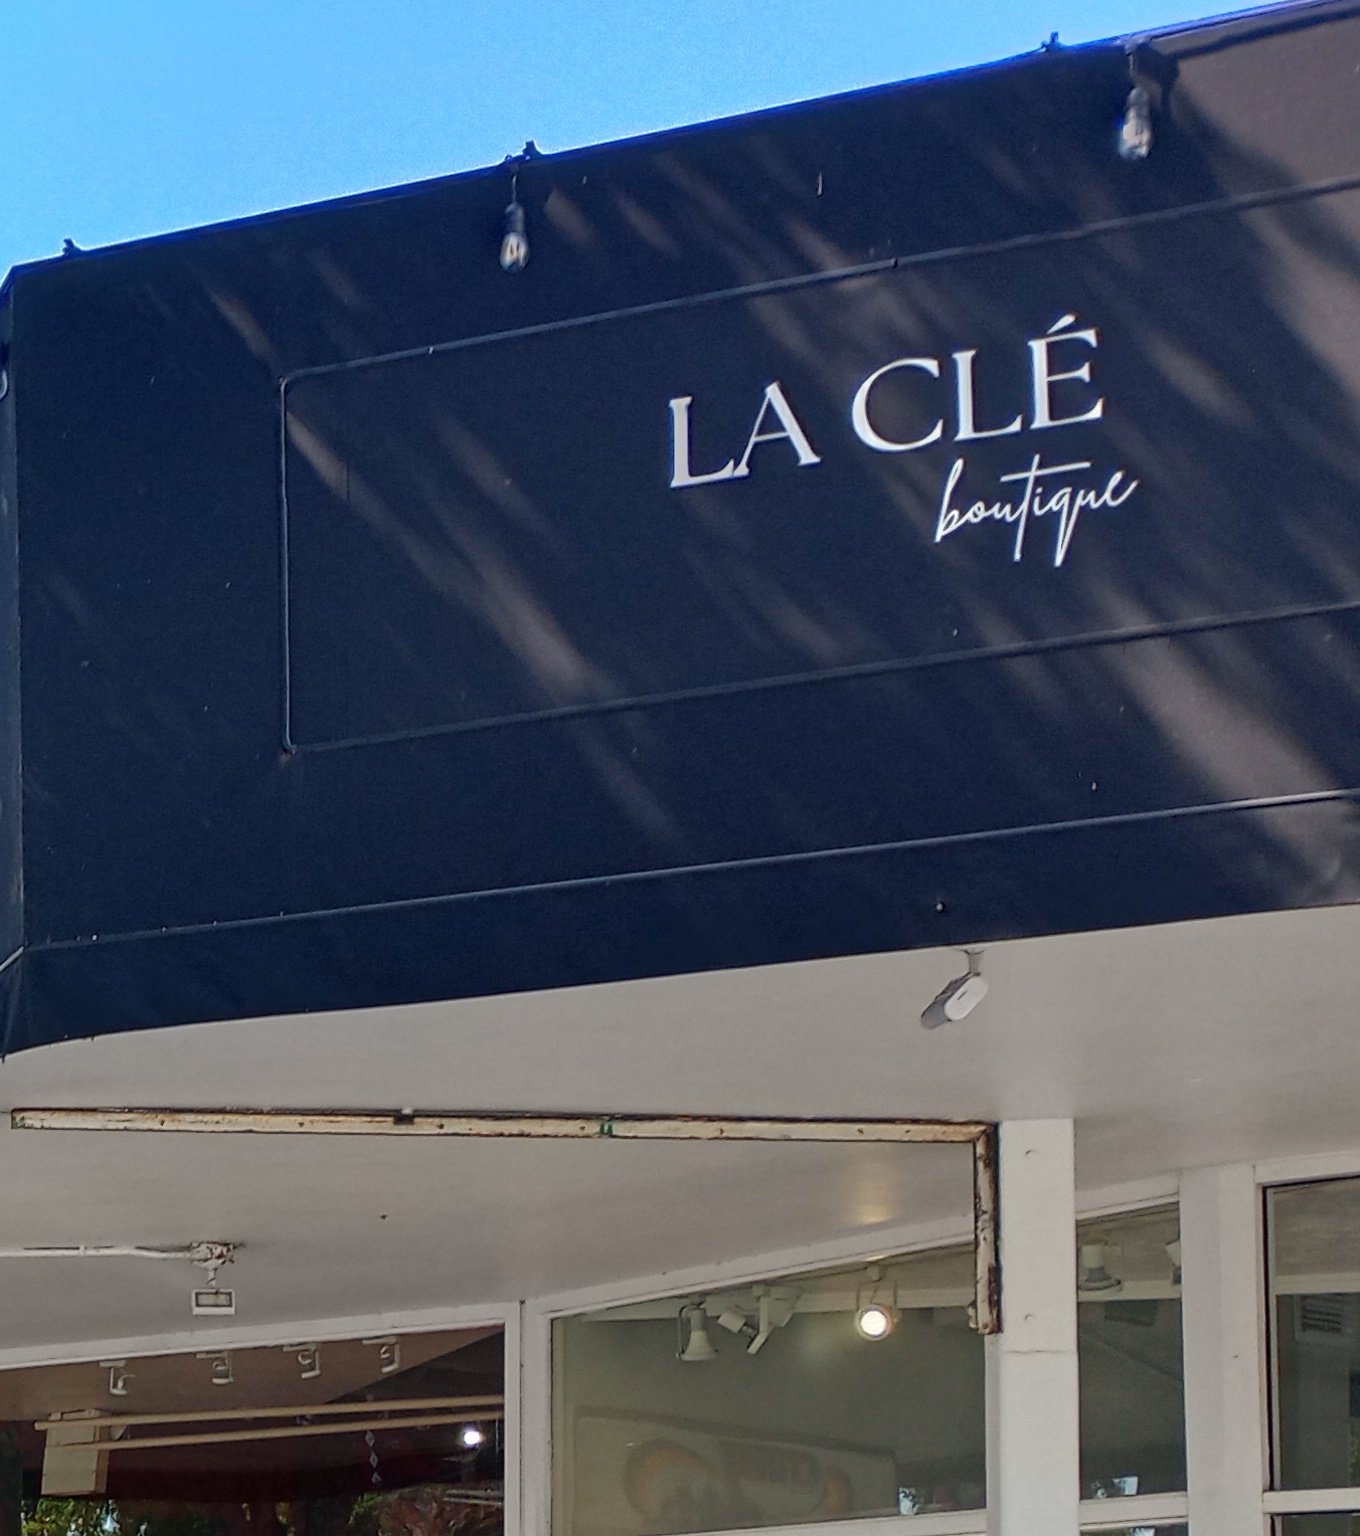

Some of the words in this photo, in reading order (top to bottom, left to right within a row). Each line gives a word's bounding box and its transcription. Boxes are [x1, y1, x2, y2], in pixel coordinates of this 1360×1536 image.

[669, 380, 821, 488] LA
[851, 312, 1105, 452] CLÉ
[934, 452, 1140, 567] boutique
